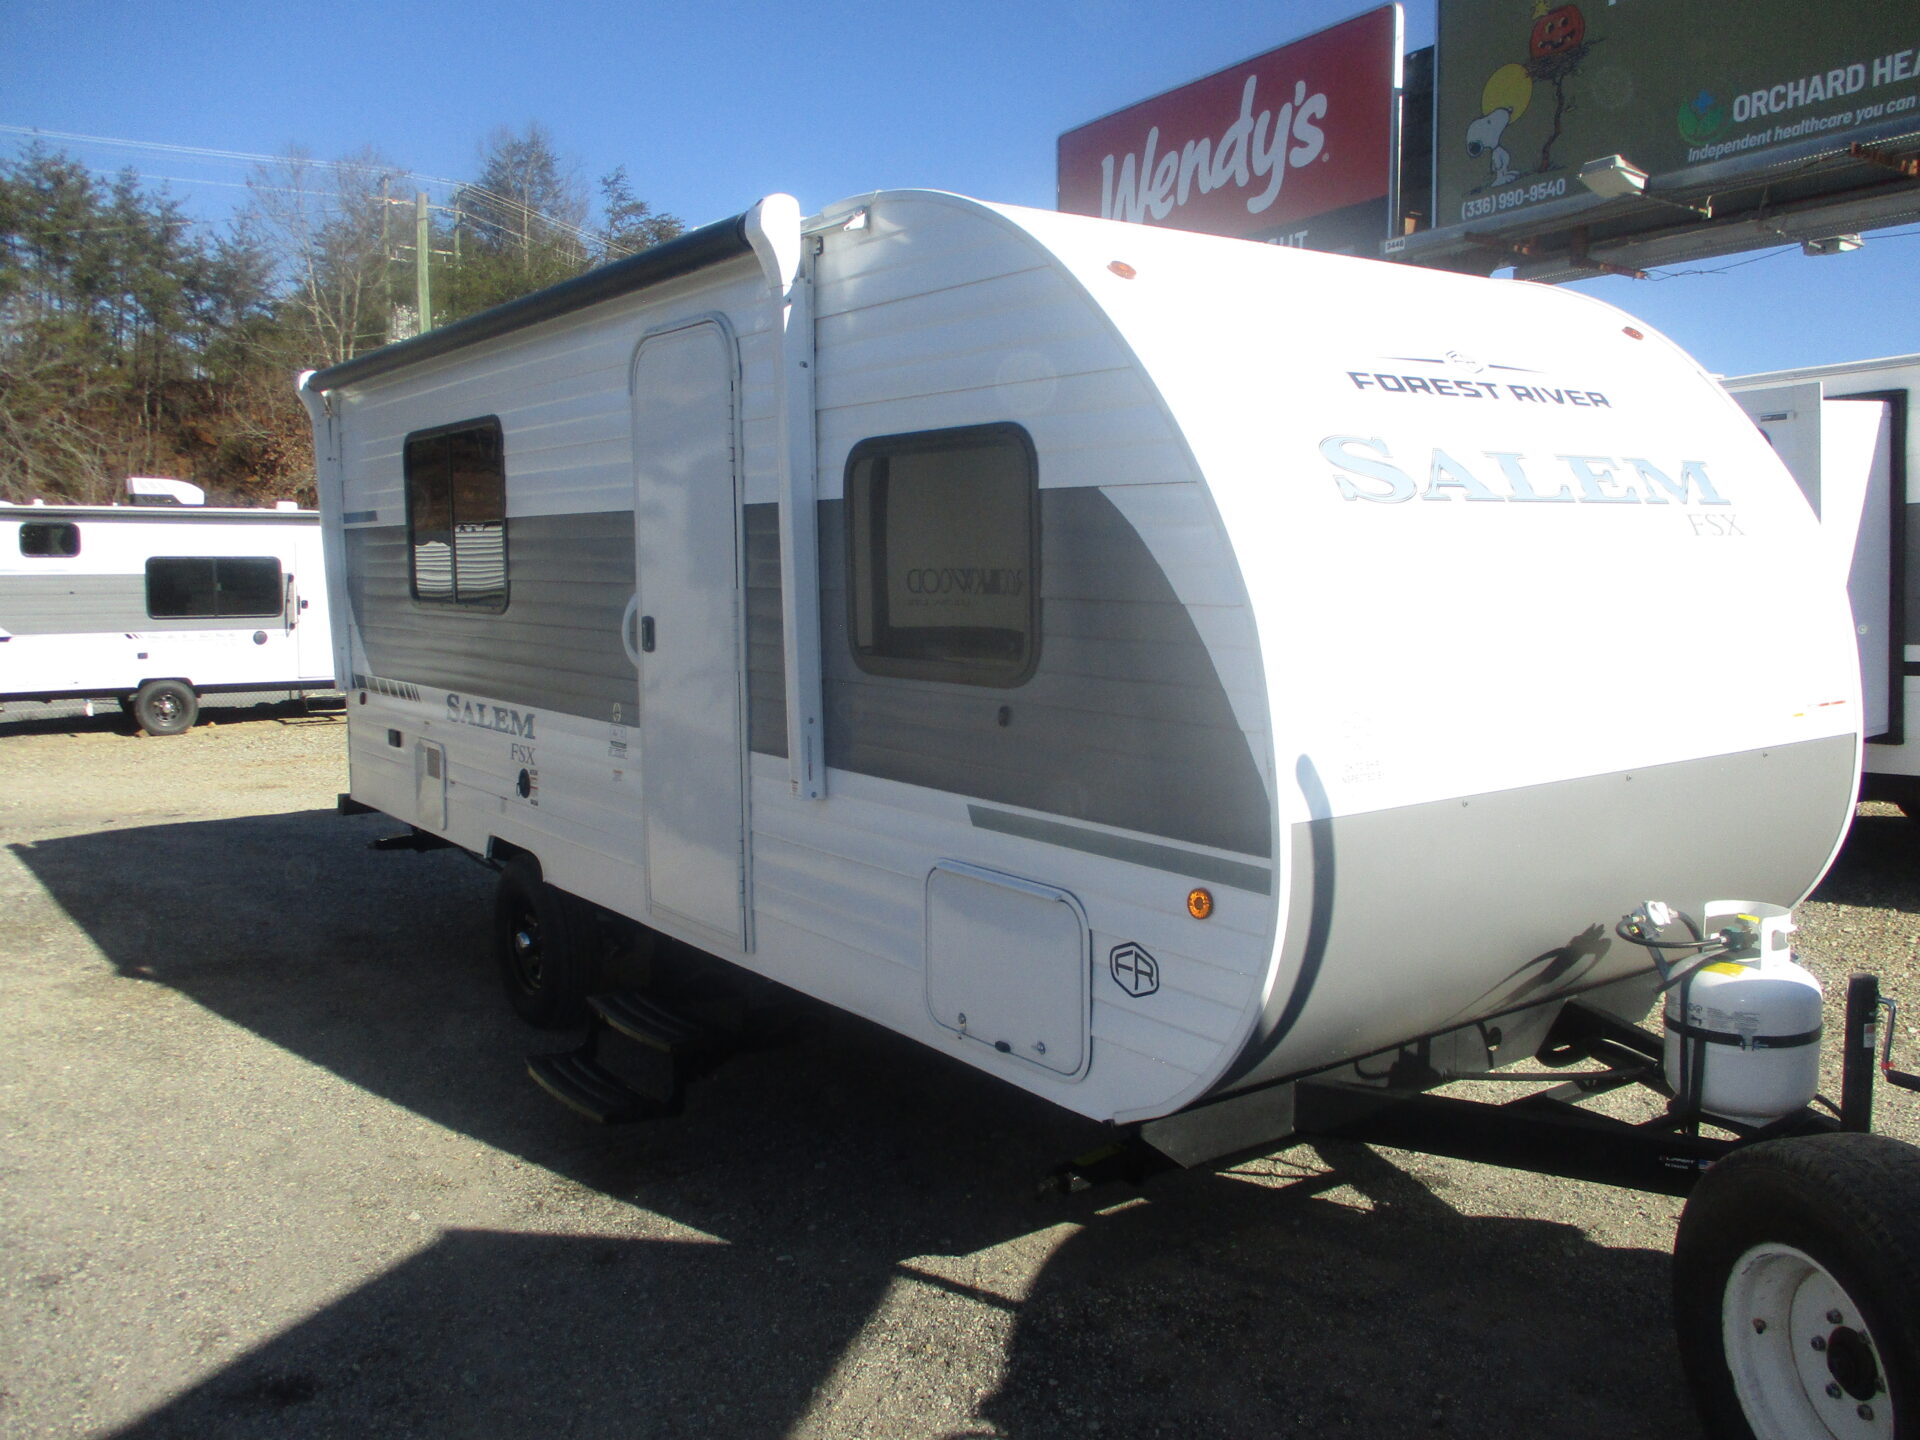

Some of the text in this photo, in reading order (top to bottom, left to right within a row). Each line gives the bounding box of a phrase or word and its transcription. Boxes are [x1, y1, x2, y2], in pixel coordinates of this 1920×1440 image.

[1733, 63, 1866, 122] ORCHARD
[1101, 75, 1328, 223] Wendy's
[1688, 95, 1917, 162] Independent healthcare you can
[1461, 178, 1565, 220] (336) 990-9540
[1345, 371, 1612, 408] FOREST RIVER
[1318, 434, 1732, 505] SALEM
[1687, 513, 1746, 536] FSX
[446, 693, 536, 740] SALEM
[510, 743, 537, 766] FSX
[1115, 950, 1154, 990] FR
